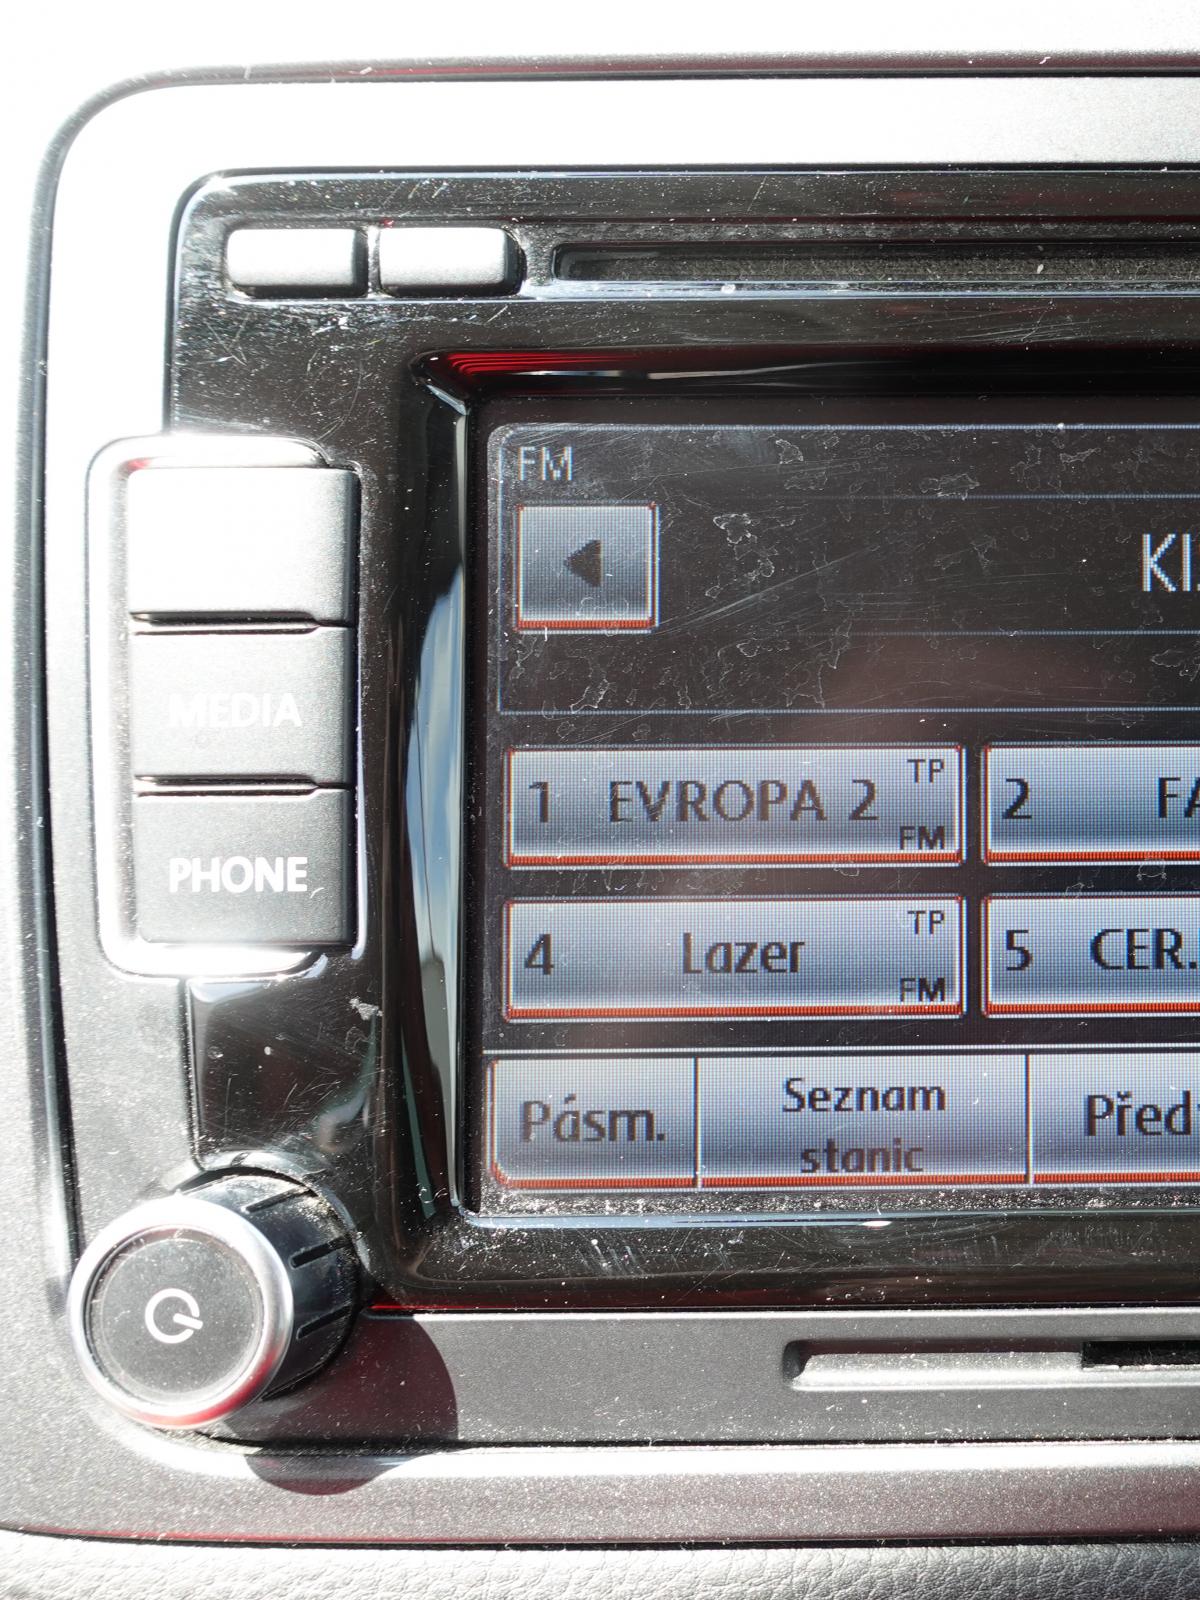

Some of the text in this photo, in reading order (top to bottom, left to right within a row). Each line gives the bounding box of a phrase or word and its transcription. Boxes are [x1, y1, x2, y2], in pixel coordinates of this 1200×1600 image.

[518, 447, 573, 481] FM
[169, 693, 301, 728] MEDIA
[907, 759, 945, 783] TP
[528, 779, 879, 823] 1 EVROPA 2
[1002, 778, 1032, 819] 2
[899, 827, 946, 850] FM
[169, 856, 308, 893] PHONE
[907, 911, 946, 934] TP
[523, 932, 805, 975] 4 Lazer
[1005, 930, 1033, 972] 5
[899, 978, 946, 1002] FM
[782, 1077, 946, 1113] Seznam
[519, 1094, 666, 1143] Pásm.
[800, 1138, 924, 1175] stanic
